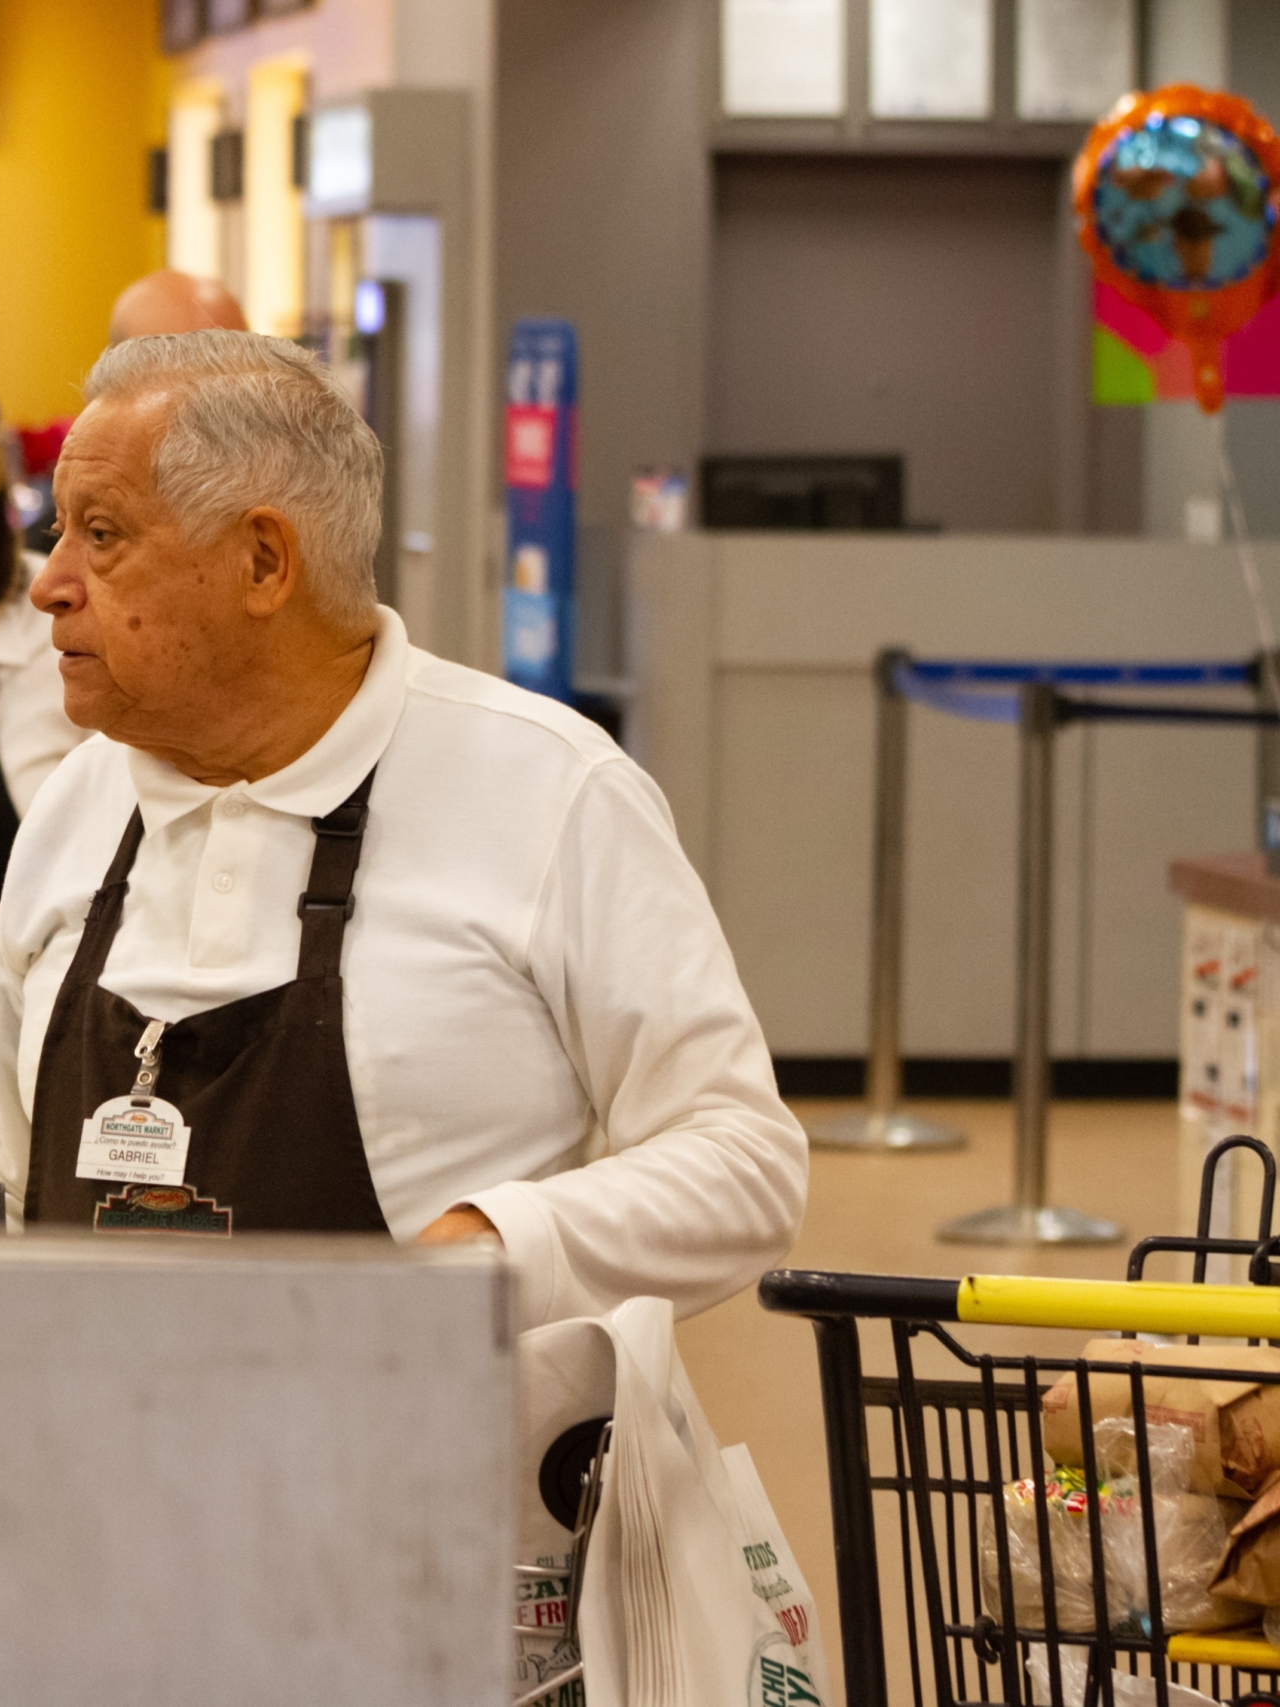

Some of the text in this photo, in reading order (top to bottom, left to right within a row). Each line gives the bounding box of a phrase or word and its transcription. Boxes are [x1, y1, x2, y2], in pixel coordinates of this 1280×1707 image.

[106, 1122, 169, 1136] NORTHGATE MARKET
[108, 1149, 160, 1165] GABRIEL
[96, 1168, 112, 1177] How
[113, 1171, 128, 1180] may
[133, 1171, 148, 1180] help
[148, 1173, 166, 1182] you?
